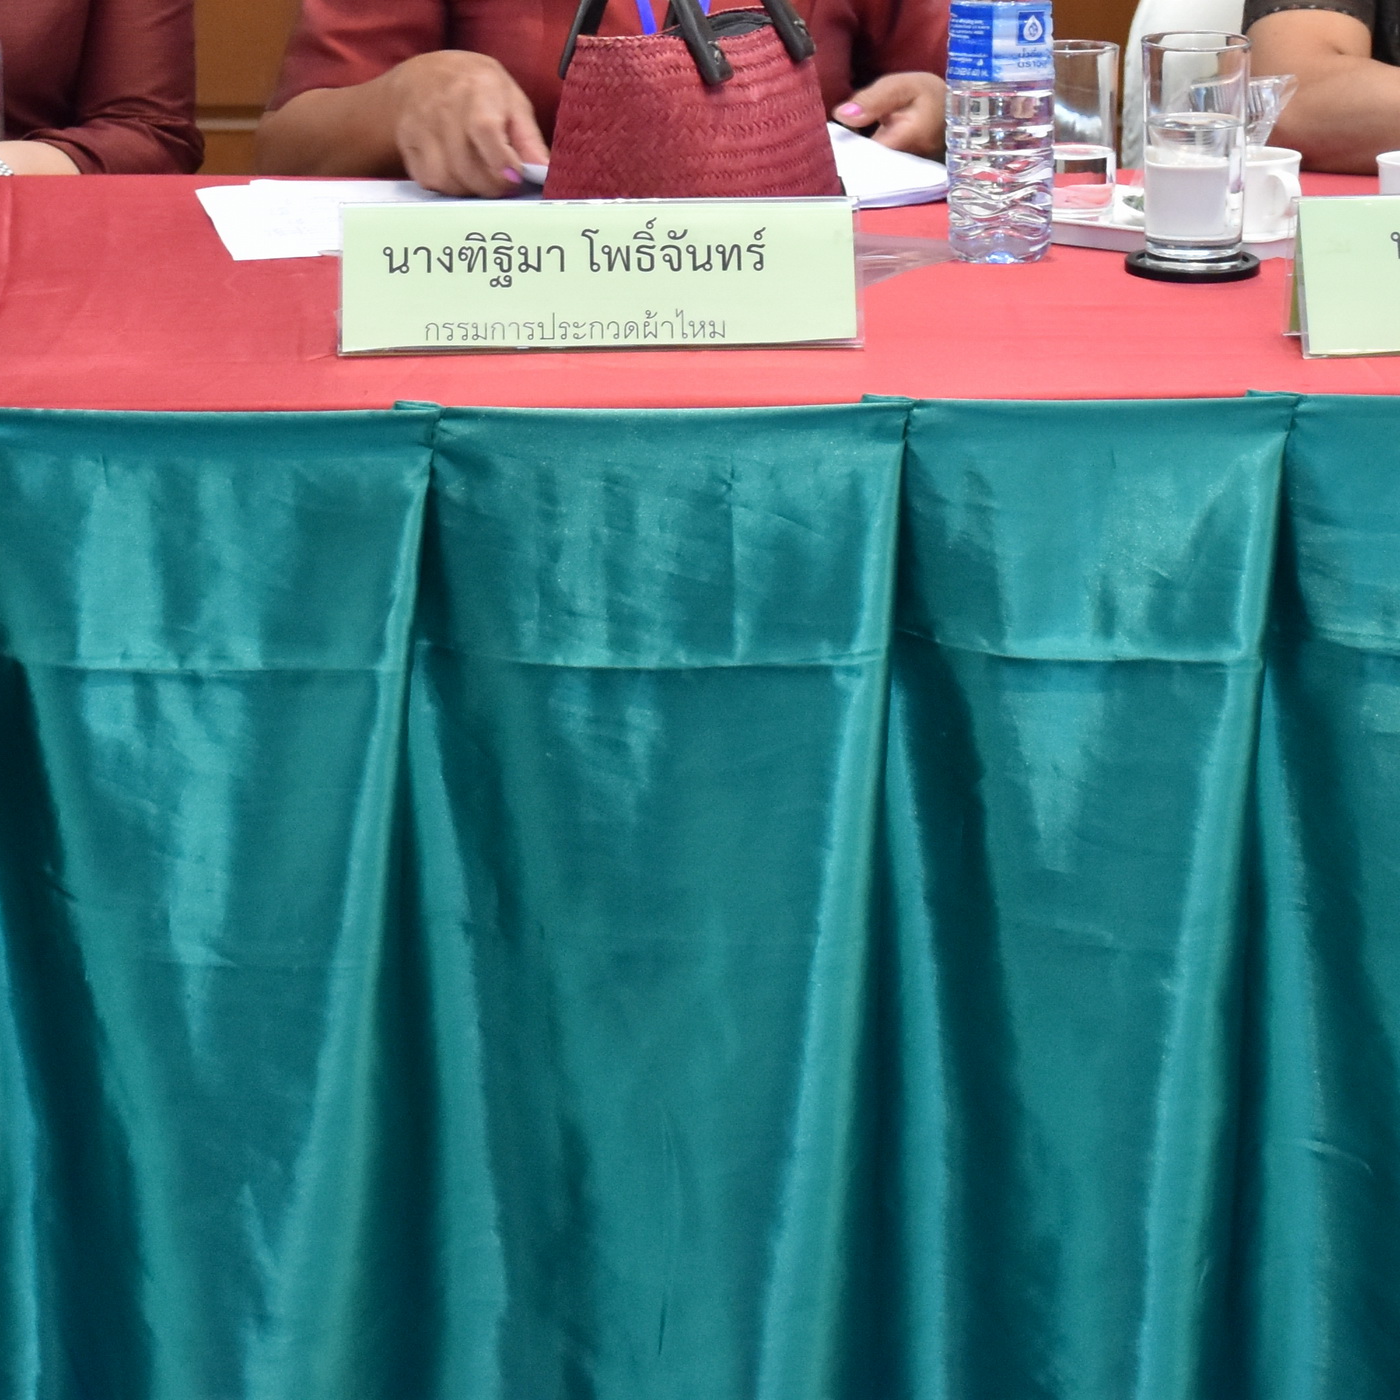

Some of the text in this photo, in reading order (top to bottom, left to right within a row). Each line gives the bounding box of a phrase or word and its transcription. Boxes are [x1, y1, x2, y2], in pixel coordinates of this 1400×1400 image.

[382, 216, 767, 289] นางฑิฐิมา โพธิ์จันทร์
[424, 307, 726, 342] กรรมการประกวดผ้าไหม
